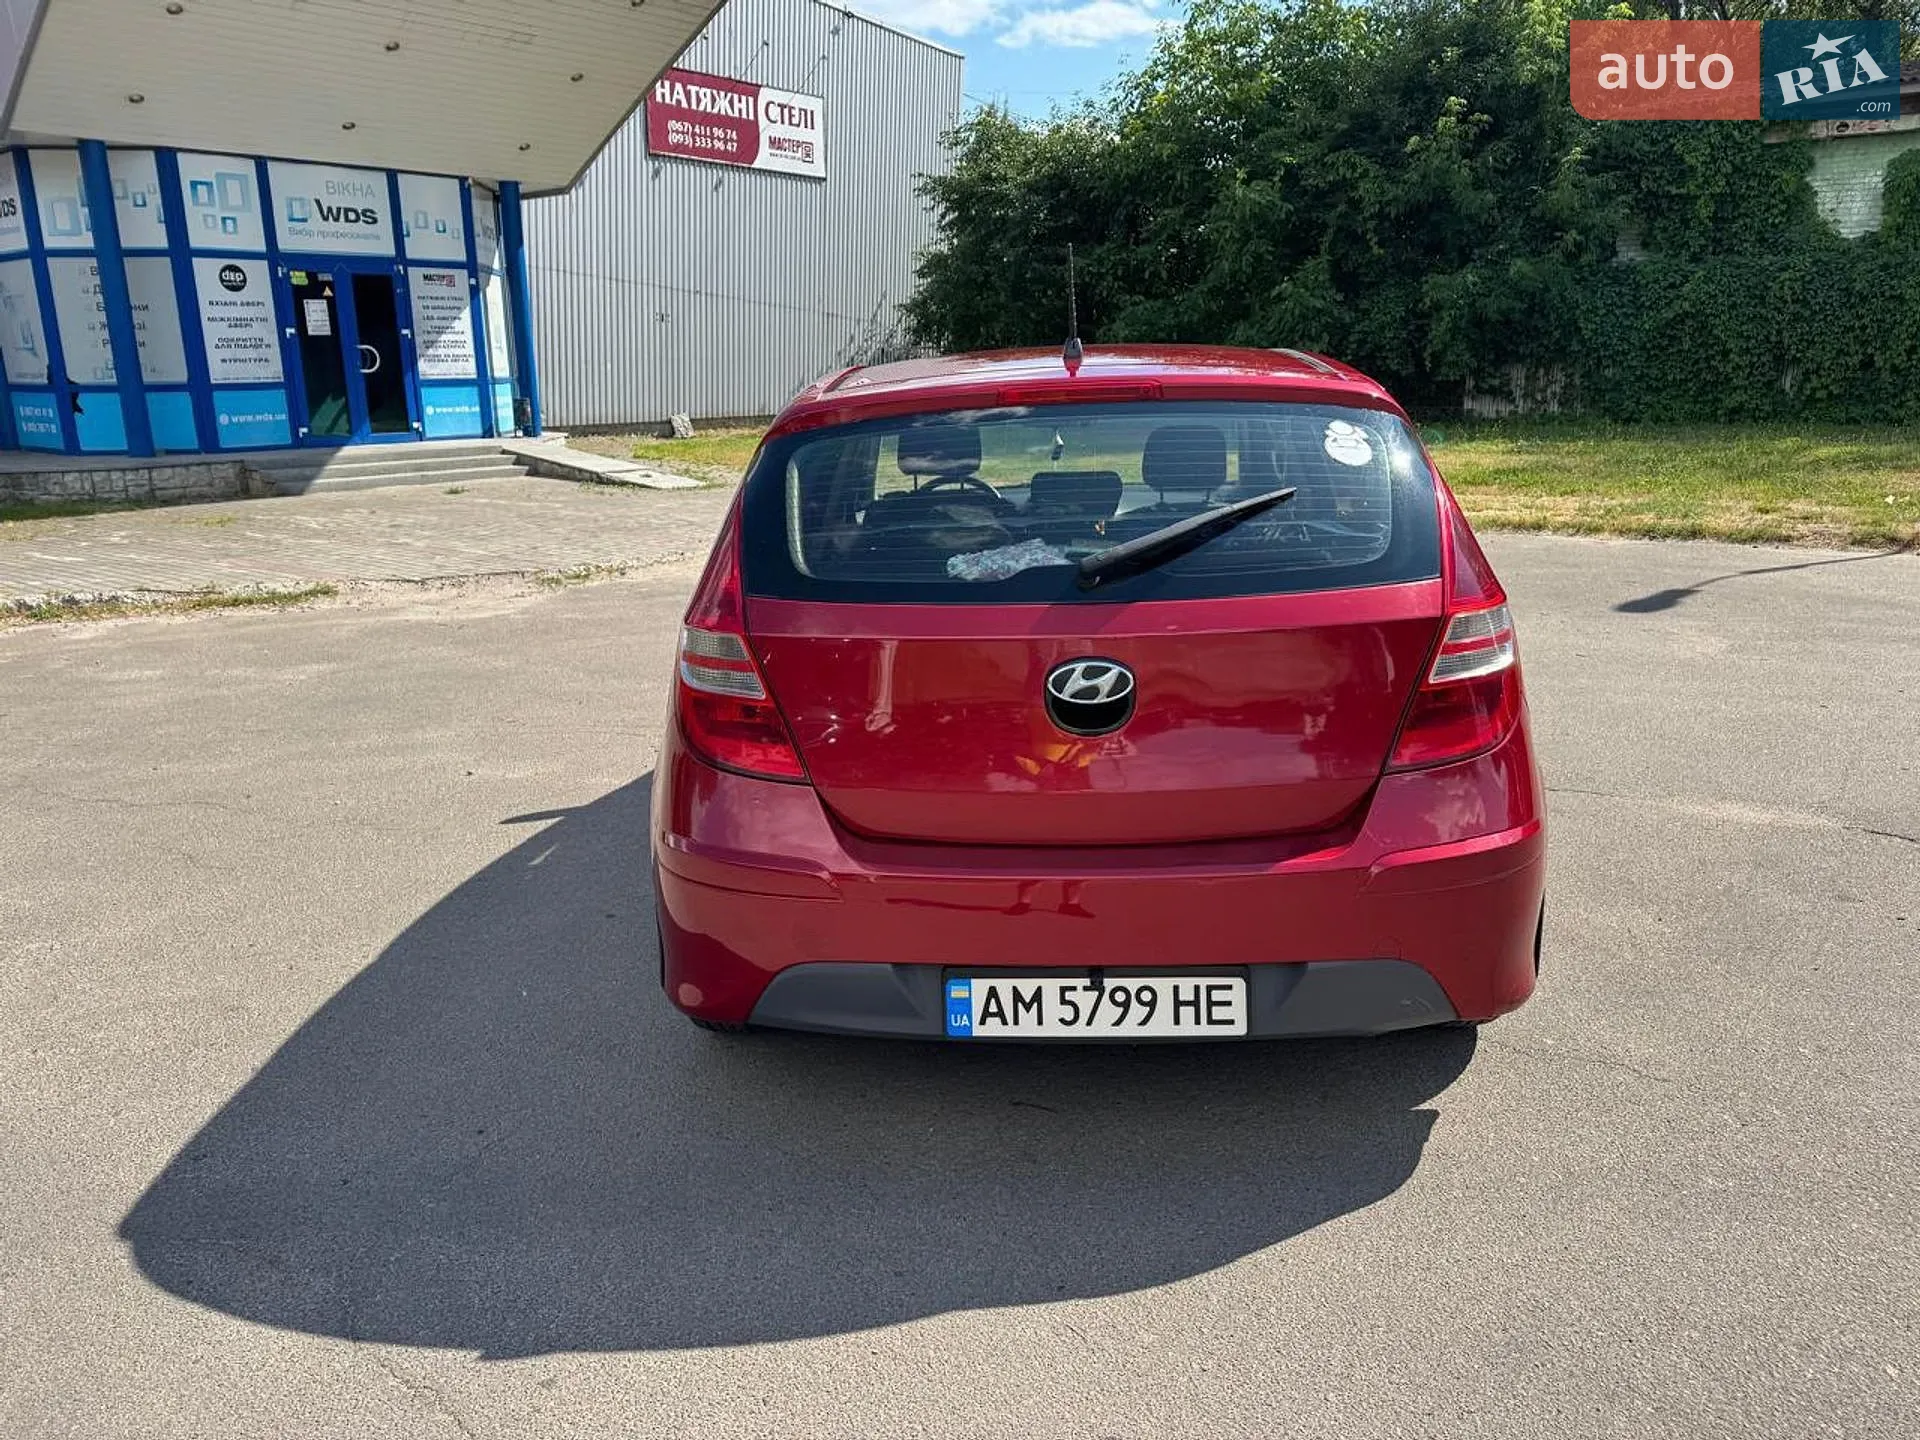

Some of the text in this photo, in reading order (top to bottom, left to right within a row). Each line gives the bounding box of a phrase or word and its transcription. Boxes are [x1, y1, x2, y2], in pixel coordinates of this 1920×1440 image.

[655, 79, 815, 131] НАТЯЖНІ СТЕЛІ
[667, 119, 738, 141] (067) 411 96 74
[668, 131, 738, 152] (093) 333 96 47
[768, 135, 801, 154] МАСТЕР
[325, 180, 376, 199] ВІКНА
[0, 198, 17, 218] DS
[314, 198, 379, 226] WDS
[978, 984, 1236, 1028] AM 5799 HE
[950, 1014, 970, 1027] UA
